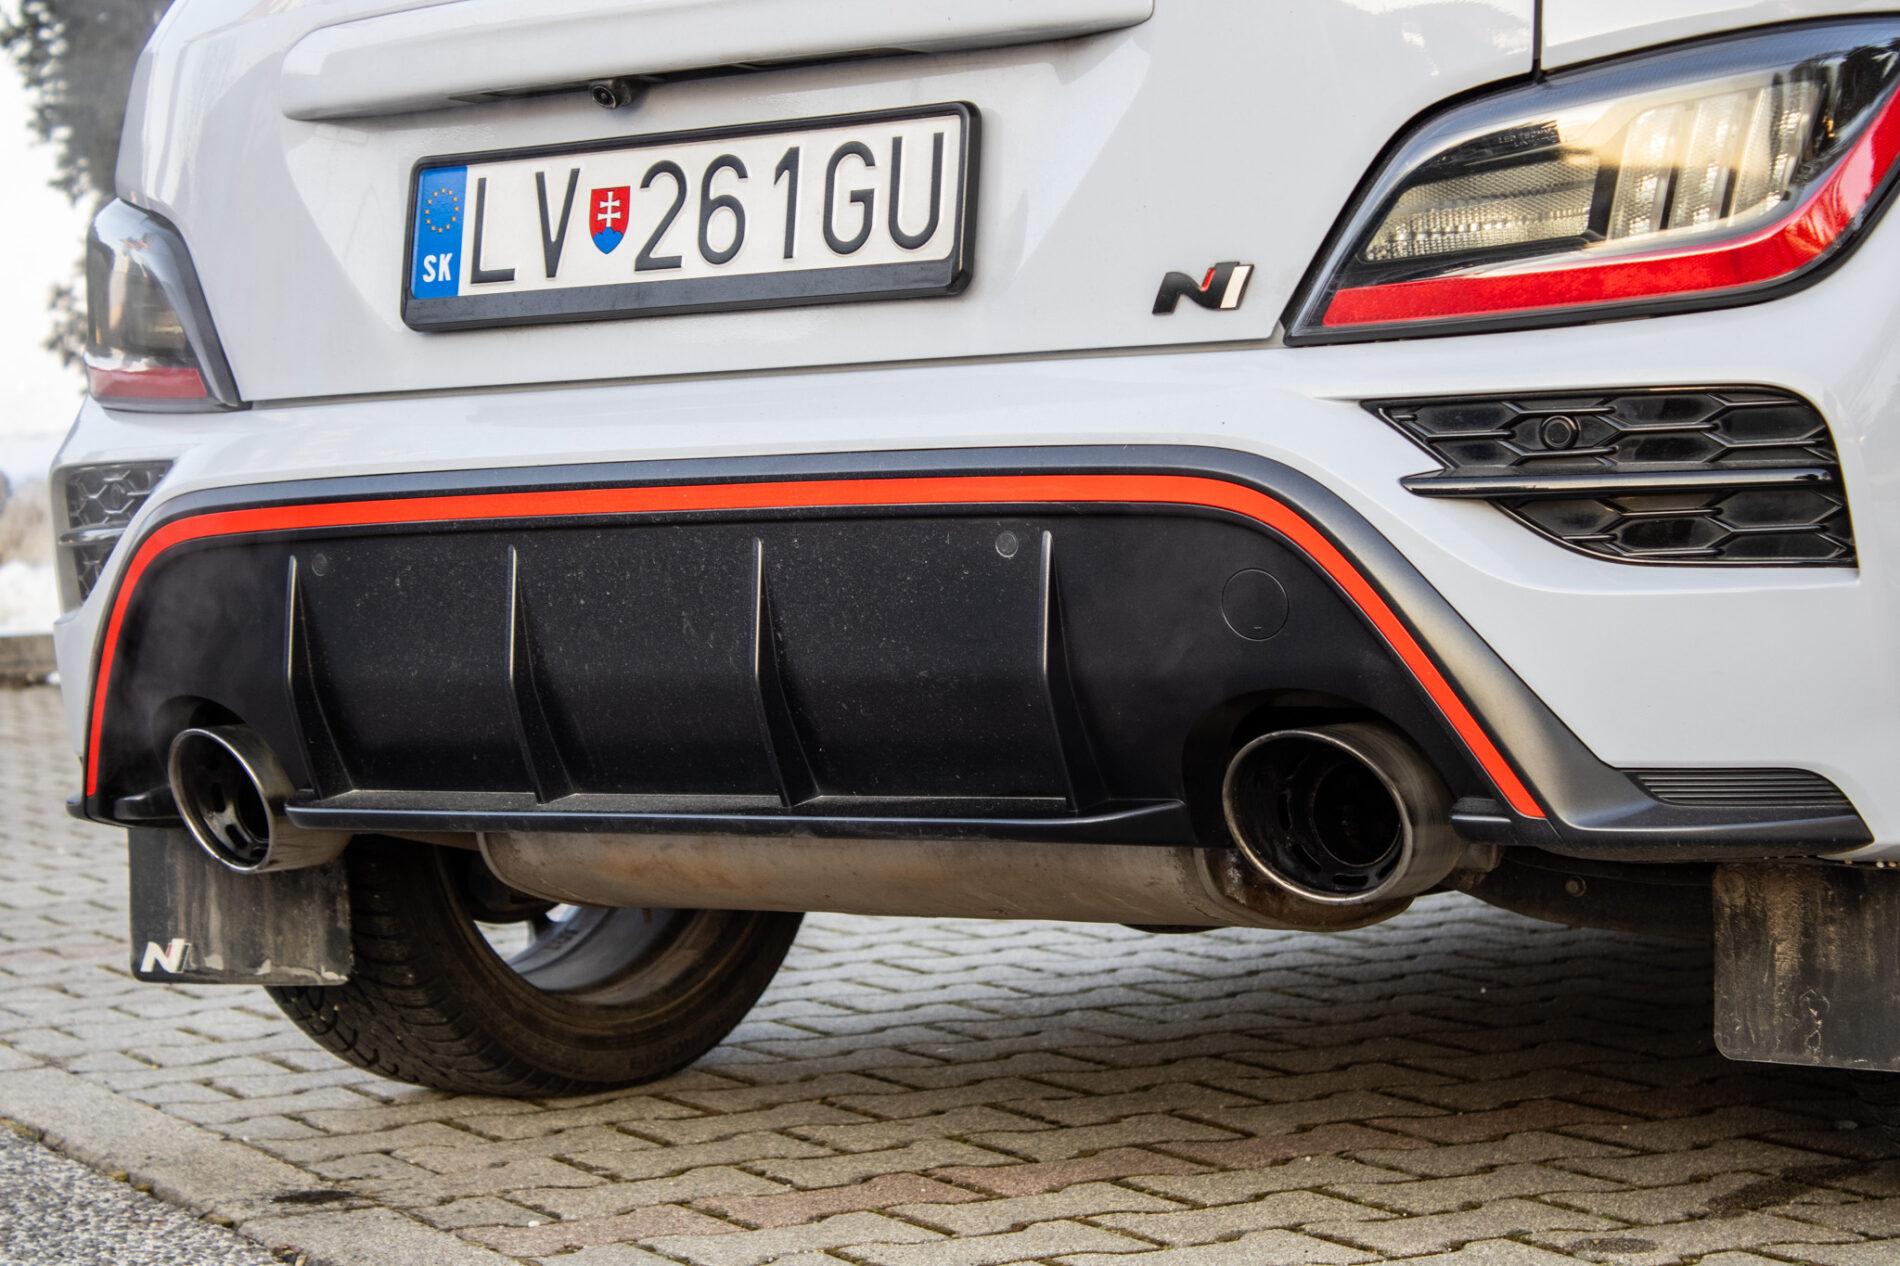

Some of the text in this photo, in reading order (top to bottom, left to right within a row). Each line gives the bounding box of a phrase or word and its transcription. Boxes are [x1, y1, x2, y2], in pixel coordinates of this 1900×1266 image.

[470, 131, 945, 284] LV 261GU
[422, 252, 453, 283] SK
